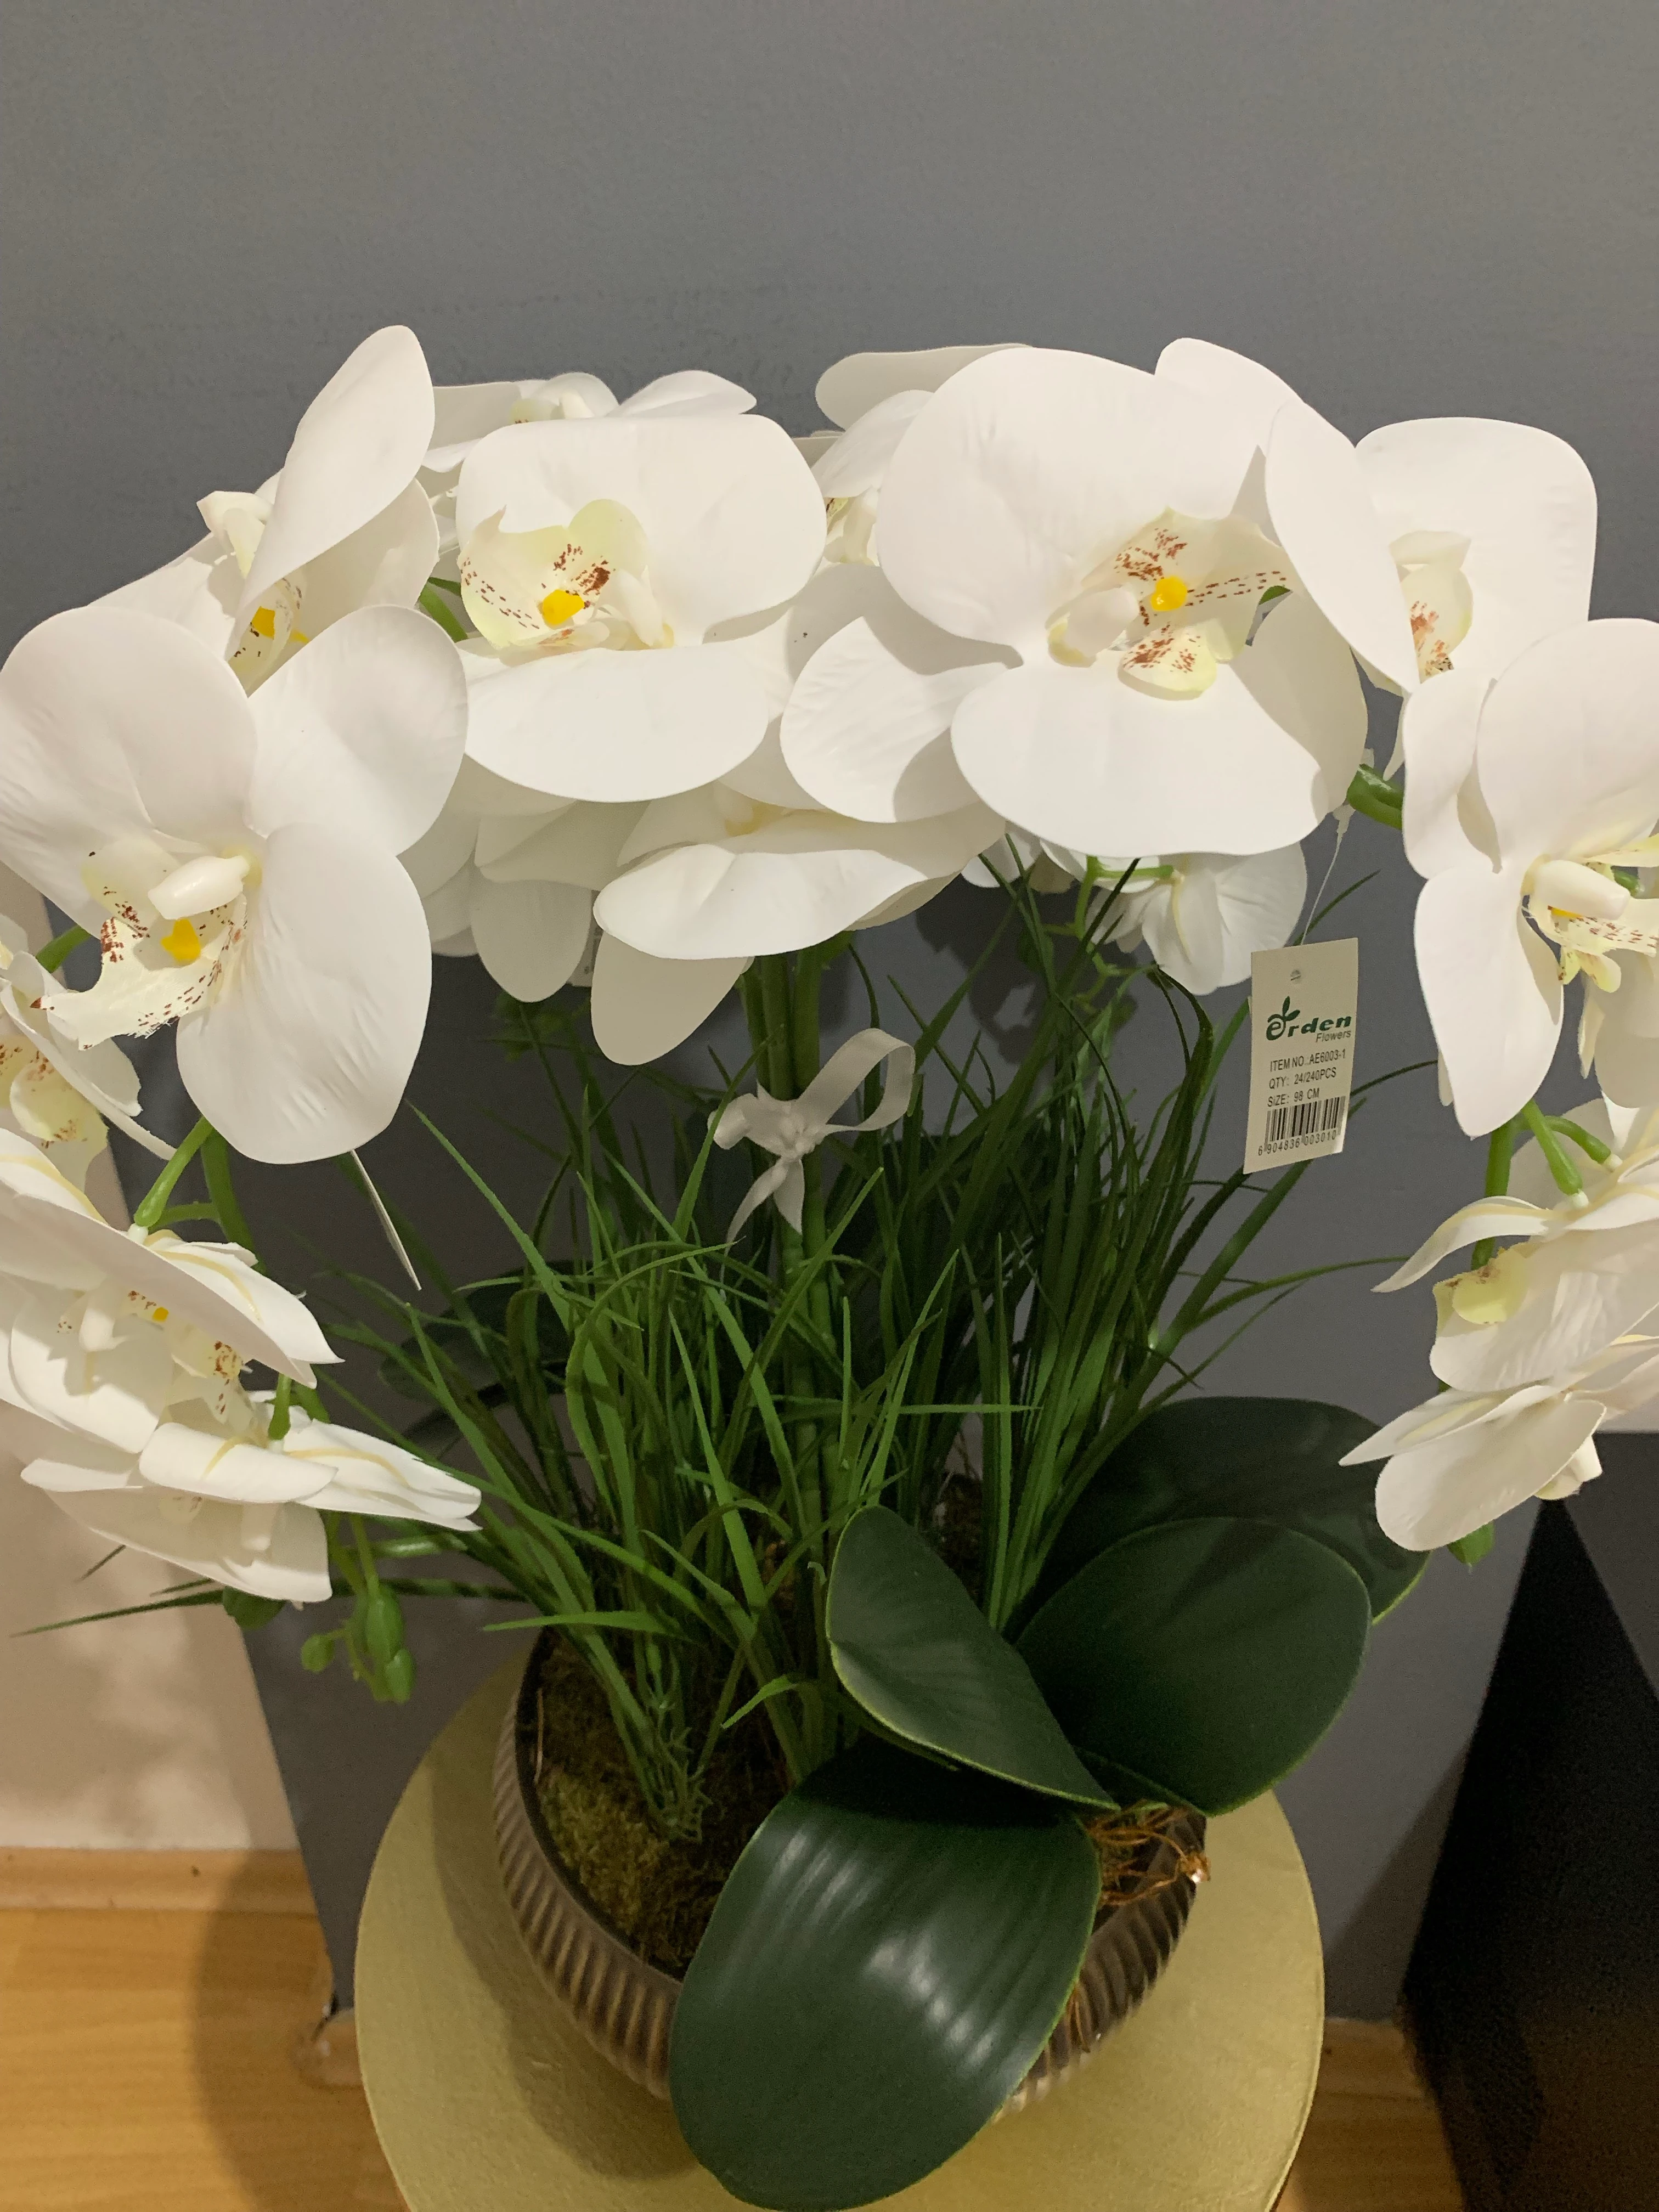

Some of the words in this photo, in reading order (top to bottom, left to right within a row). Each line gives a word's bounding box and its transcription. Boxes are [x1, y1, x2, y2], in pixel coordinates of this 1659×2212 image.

[1316, 1030, 1351, 1042] Flowers
[1270, 1058, 1290, 1072] ITEM
[1294, 1066, 1336, 1085] 24/240PCS
[1294, 1090, 1304, 1102] 98
[1307, 1087, 1319, 1099] CM
